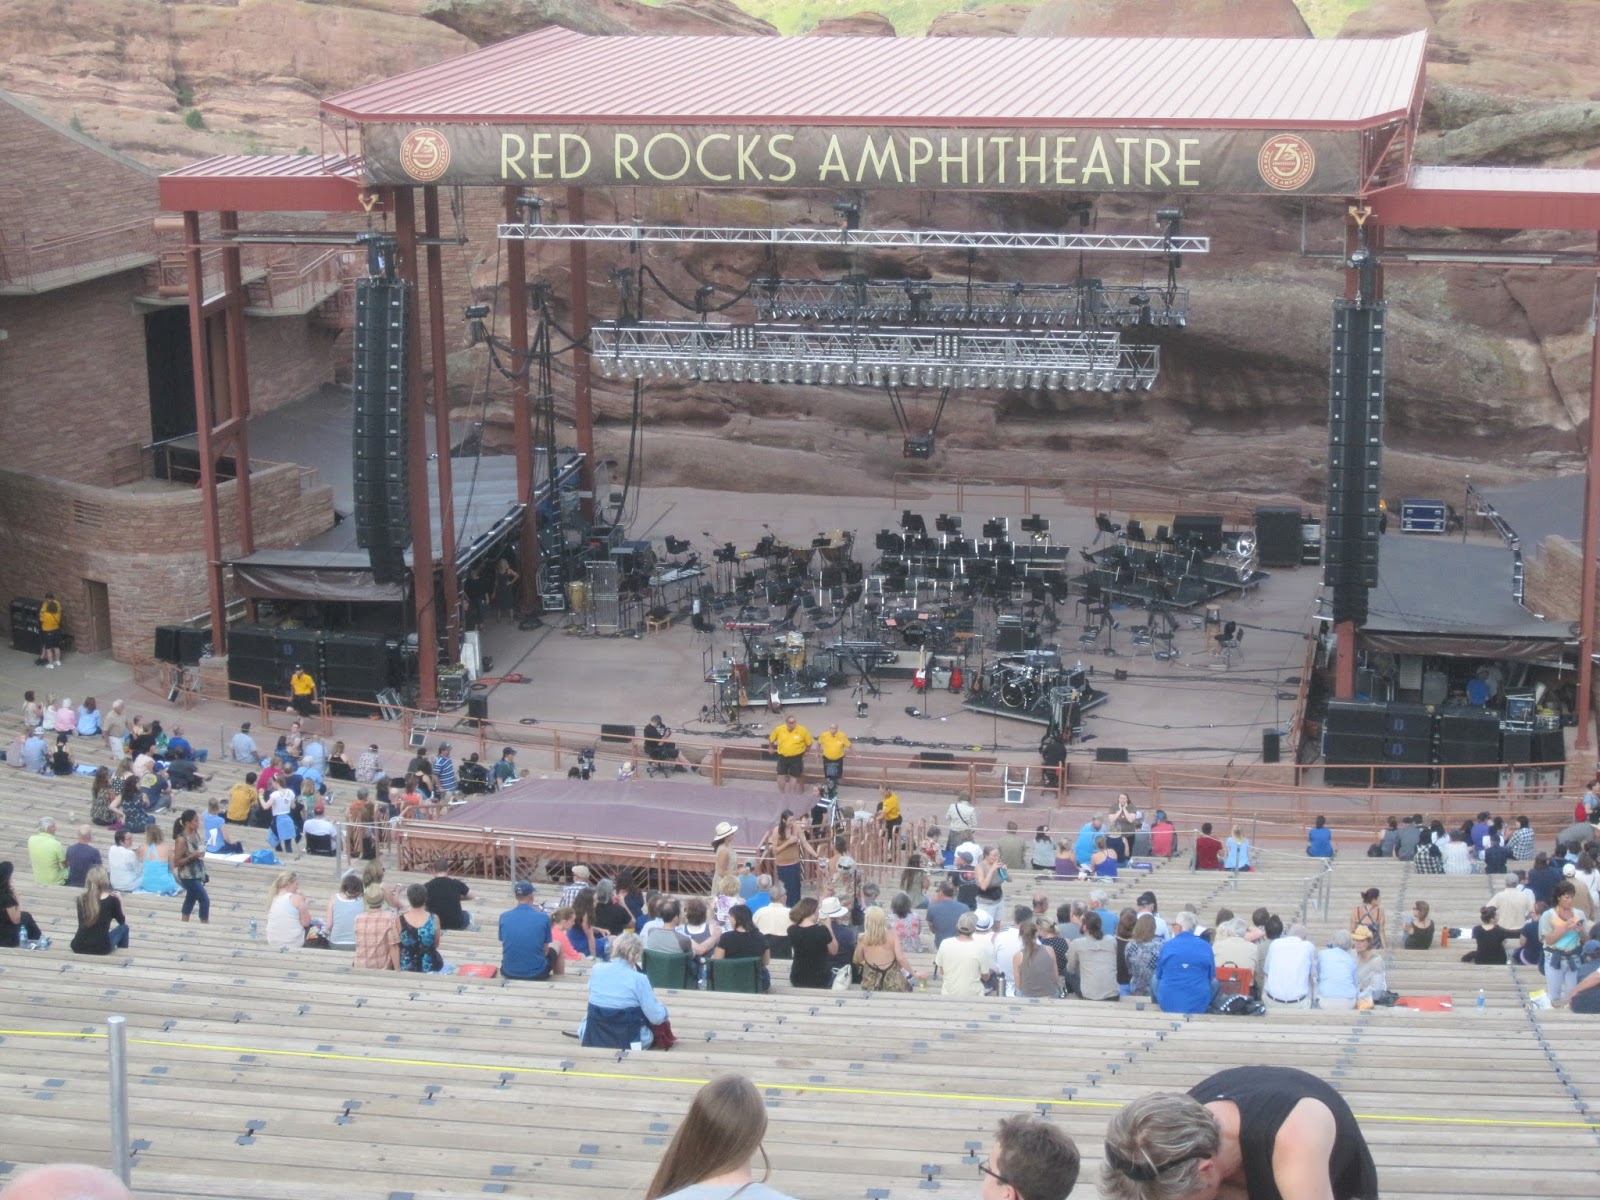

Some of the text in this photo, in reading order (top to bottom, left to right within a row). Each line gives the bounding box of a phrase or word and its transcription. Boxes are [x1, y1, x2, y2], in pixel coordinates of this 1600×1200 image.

[412, 136, 438, 169] 75
[501, 132, 1201, 187] RED ROCKS AMPHITHEATRE
[1272, 143, 1301, 177] 75
